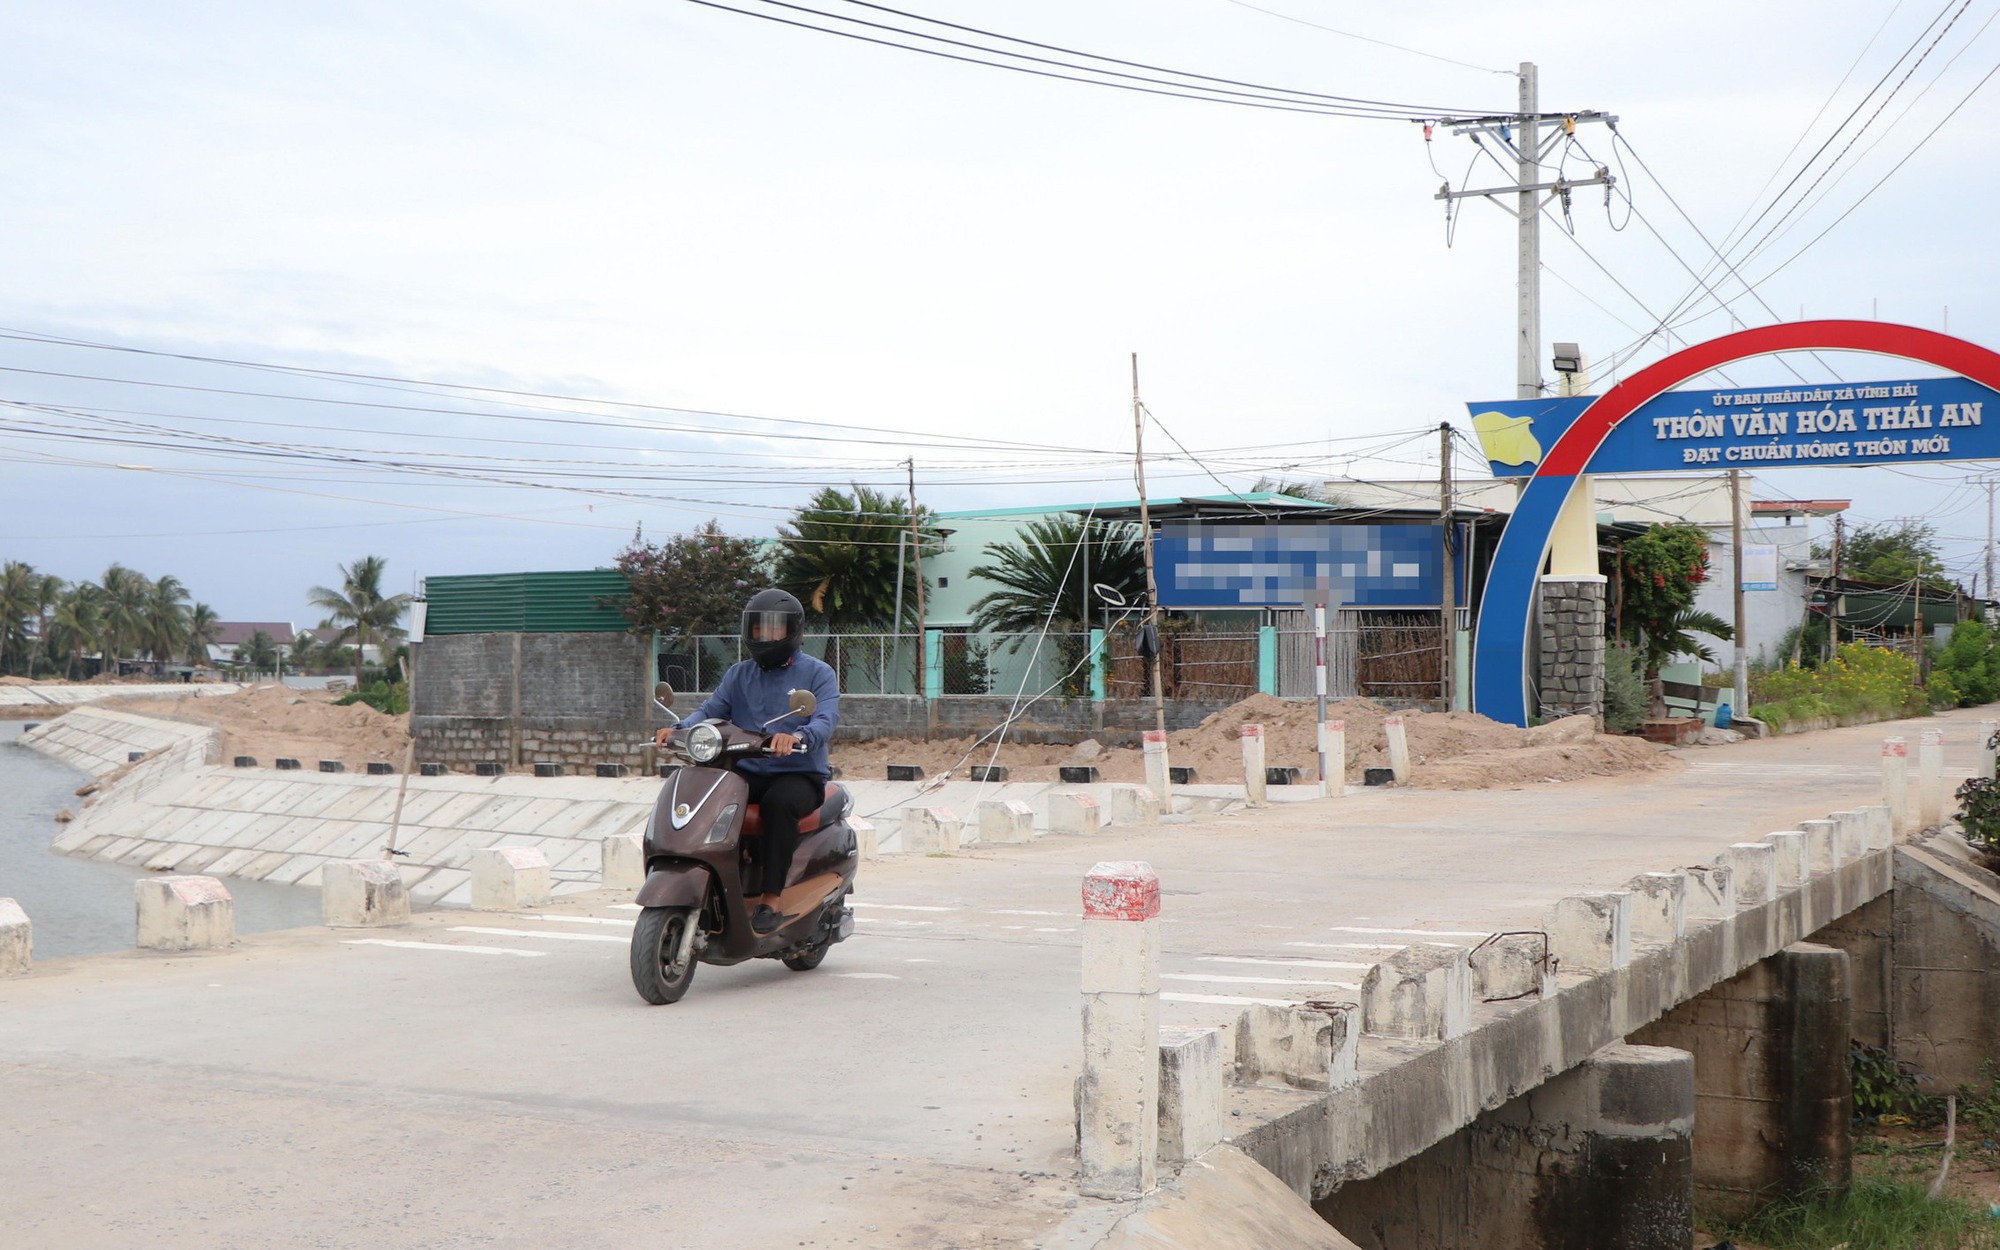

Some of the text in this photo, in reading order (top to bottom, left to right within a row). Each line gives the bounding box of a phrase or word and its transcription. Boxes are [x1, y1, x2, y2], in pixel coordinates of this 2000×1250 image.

[1712, 383, 1918, 406] ỦY BAN NHÂN DÂN XÃ VĨNH HẢI
[1653, 400, 1983, 439] THÔN VĂN HÓA THÁI AN
[1683, 434, 1950, 464] ĐẠT CHUẨN NÔNG THÔN MỚI
